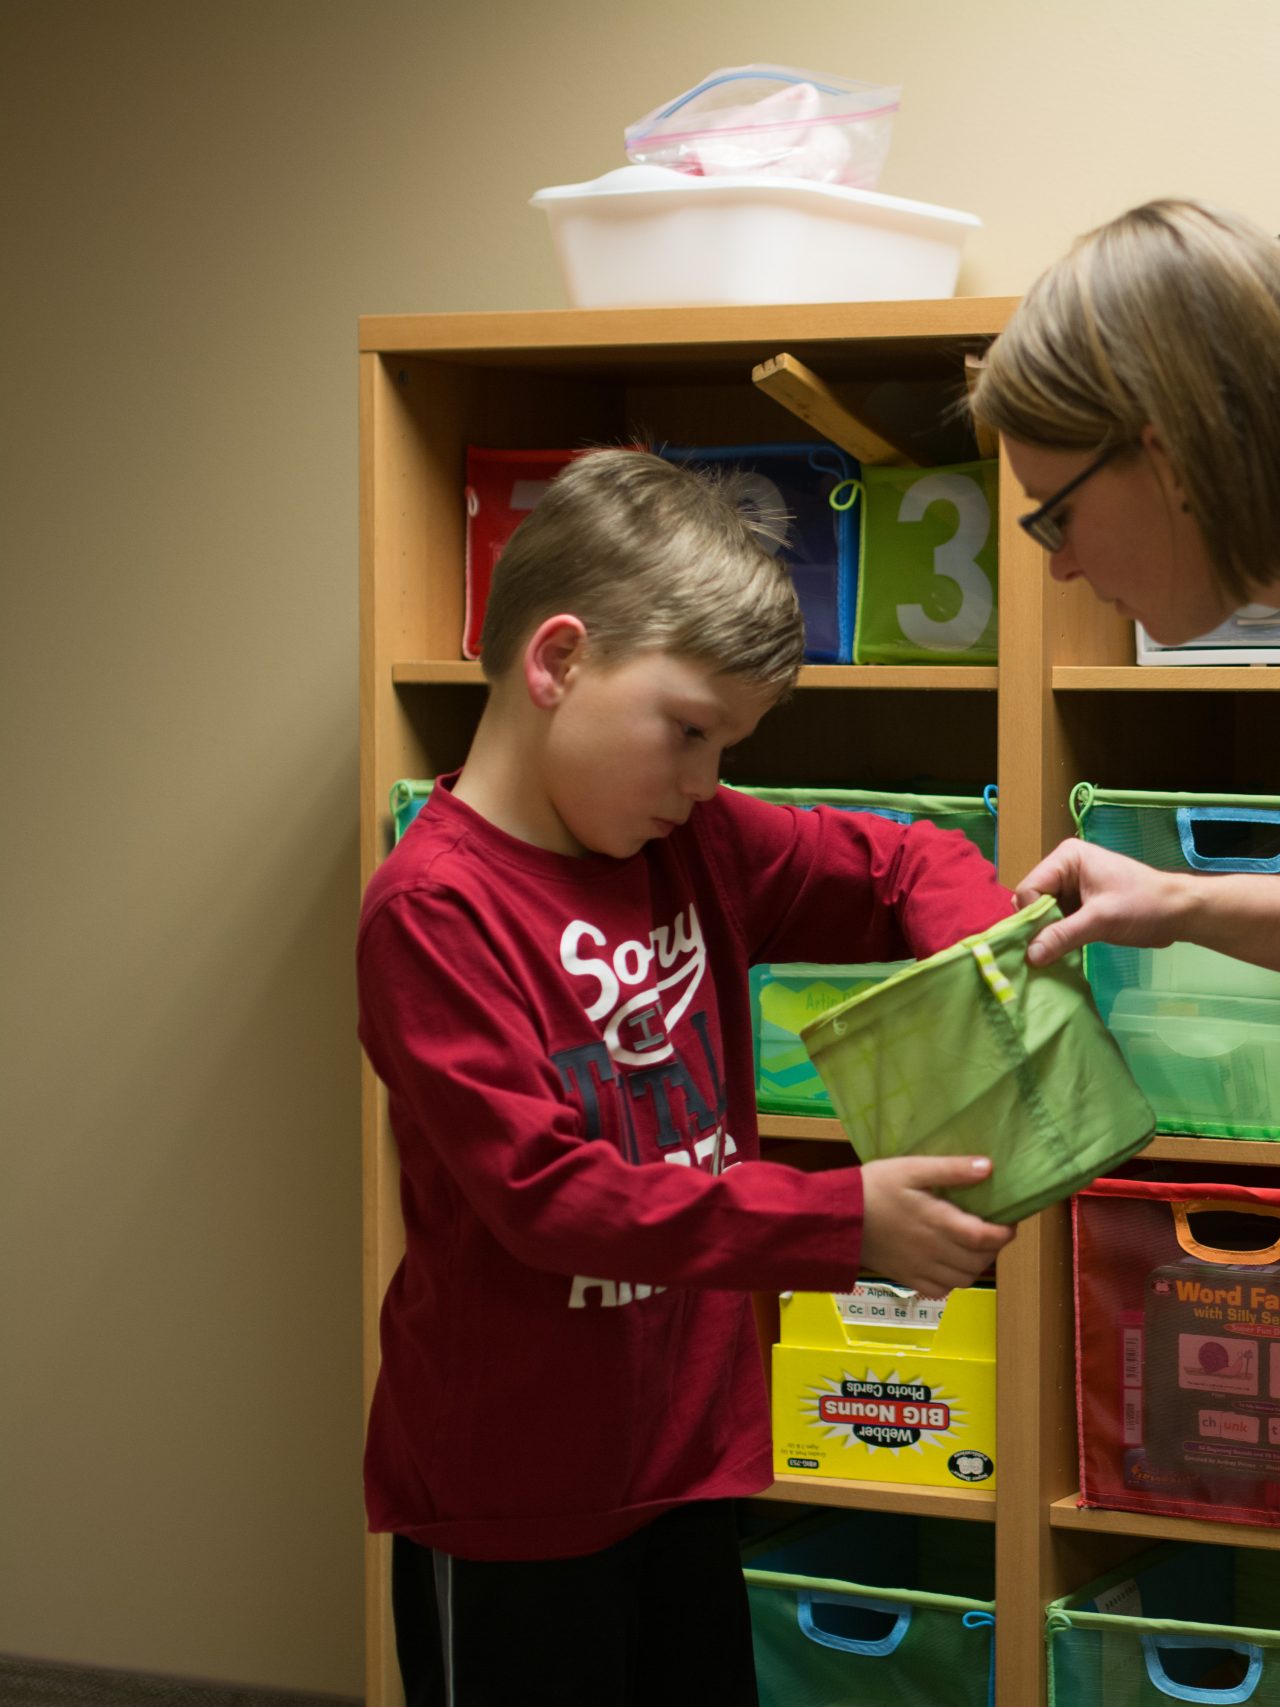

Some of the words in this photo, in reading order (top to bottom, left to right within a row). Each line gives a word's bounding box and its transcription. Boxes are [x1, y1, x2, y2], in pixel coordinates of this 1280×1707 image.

[897, 474, 994, 651] 3
[867, 1287, 900, 1298] Alpha
[1175, 1280, 1242, 1306] Word
[849, 1305, 863, 1314] Cc
[871, 1306, 885, 1316] Dd
[894, 1308, 907, 1317] Ee
[1194, 1306, 1223, 1320] with
[1227, 1308, 1257, 1325] Silly
[846, 1382, 883, 1397] Cards
[887, 1385, 925, 1400] Photo
[825, 1400, 896, 1422] Nouns
[903, 1407, 944, 1426] BIG
[1202, 1417, 1217, 1428] ch
[1224, 1421, 1248, 1433] unk
[860, 1427, 913, 1443] Webber
